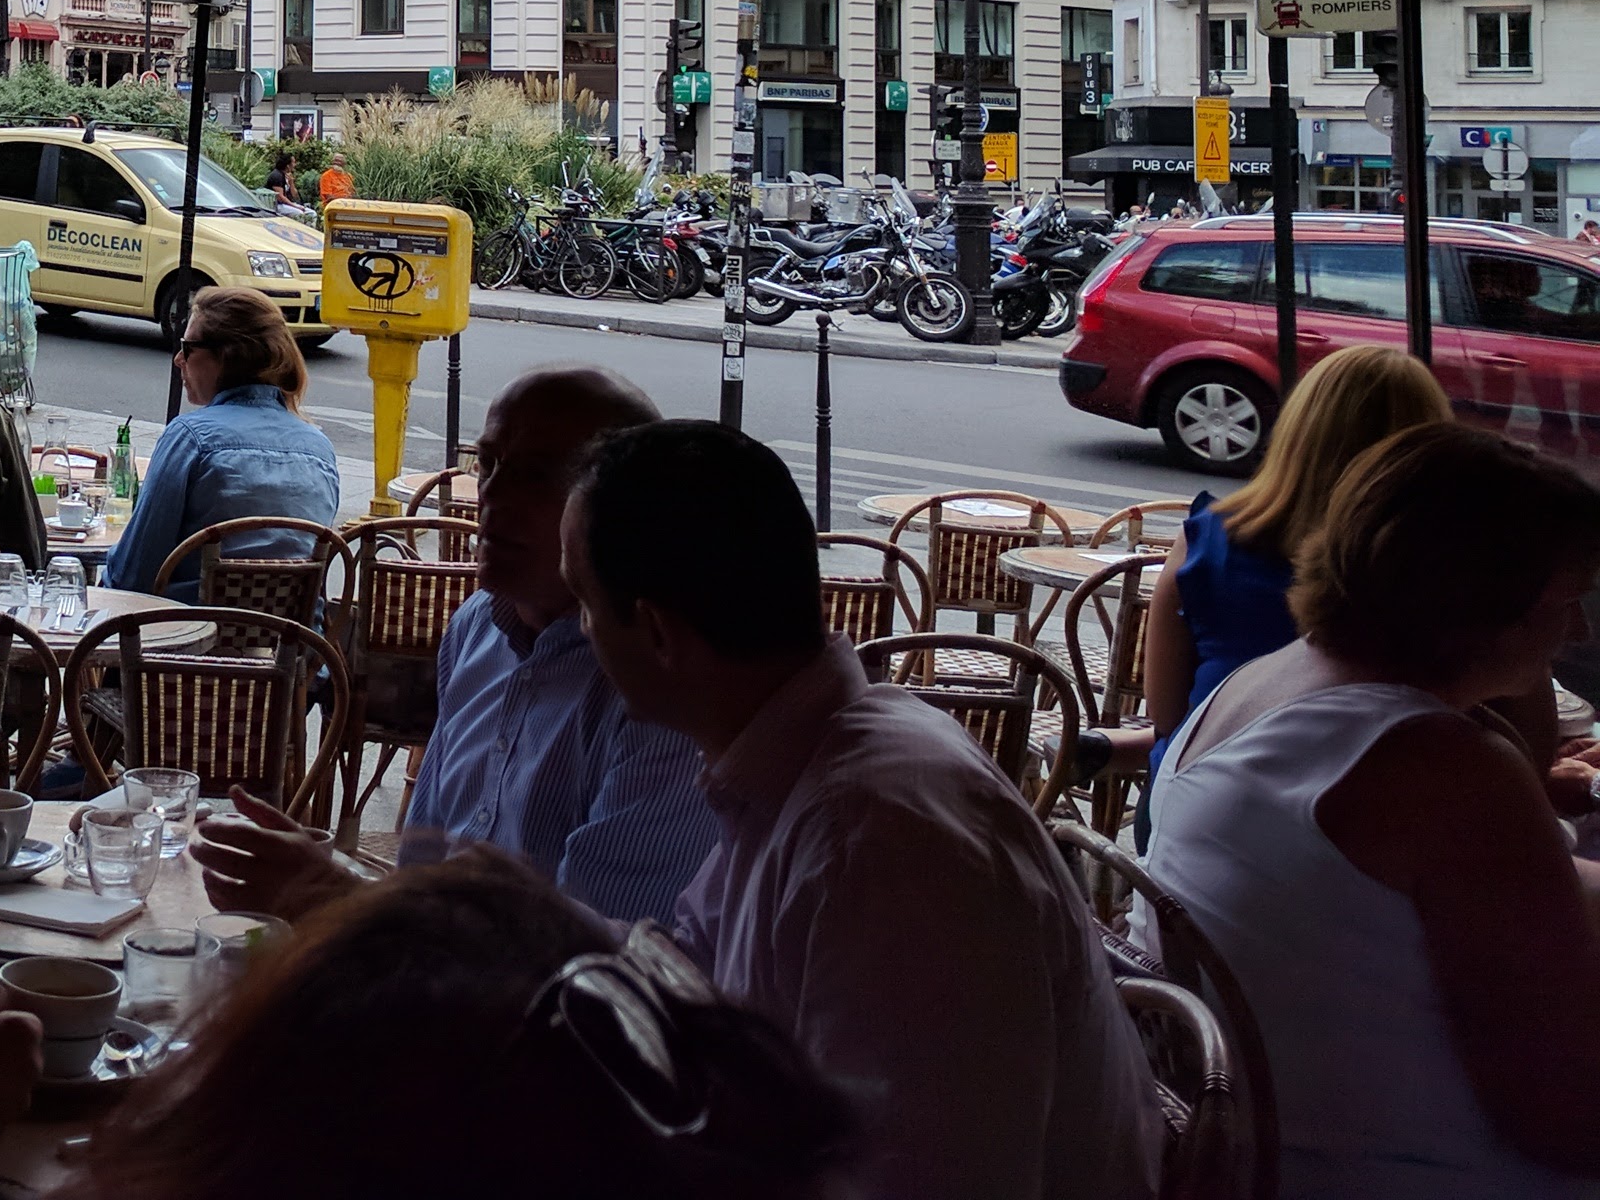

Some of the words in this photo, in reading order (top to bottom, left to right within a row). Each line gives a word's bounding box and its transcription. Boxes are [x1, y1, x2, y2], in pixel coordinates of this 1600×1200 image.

[1311, 0, 1392, 14] POMPIERS
[1084, 80, 1095, 89] LE
[767, 87, 788, 96] BNP
[789, 88, 831, 98] PARIBAS
[1086, 91, 1095, 103] 3
[979, 96, 1012, 106] ARIBAS
[1132, 159, 1161, 171] PUB
[1164, 160, 1195, 172] CAF
[1229, 161, 1273, 174] NCER
